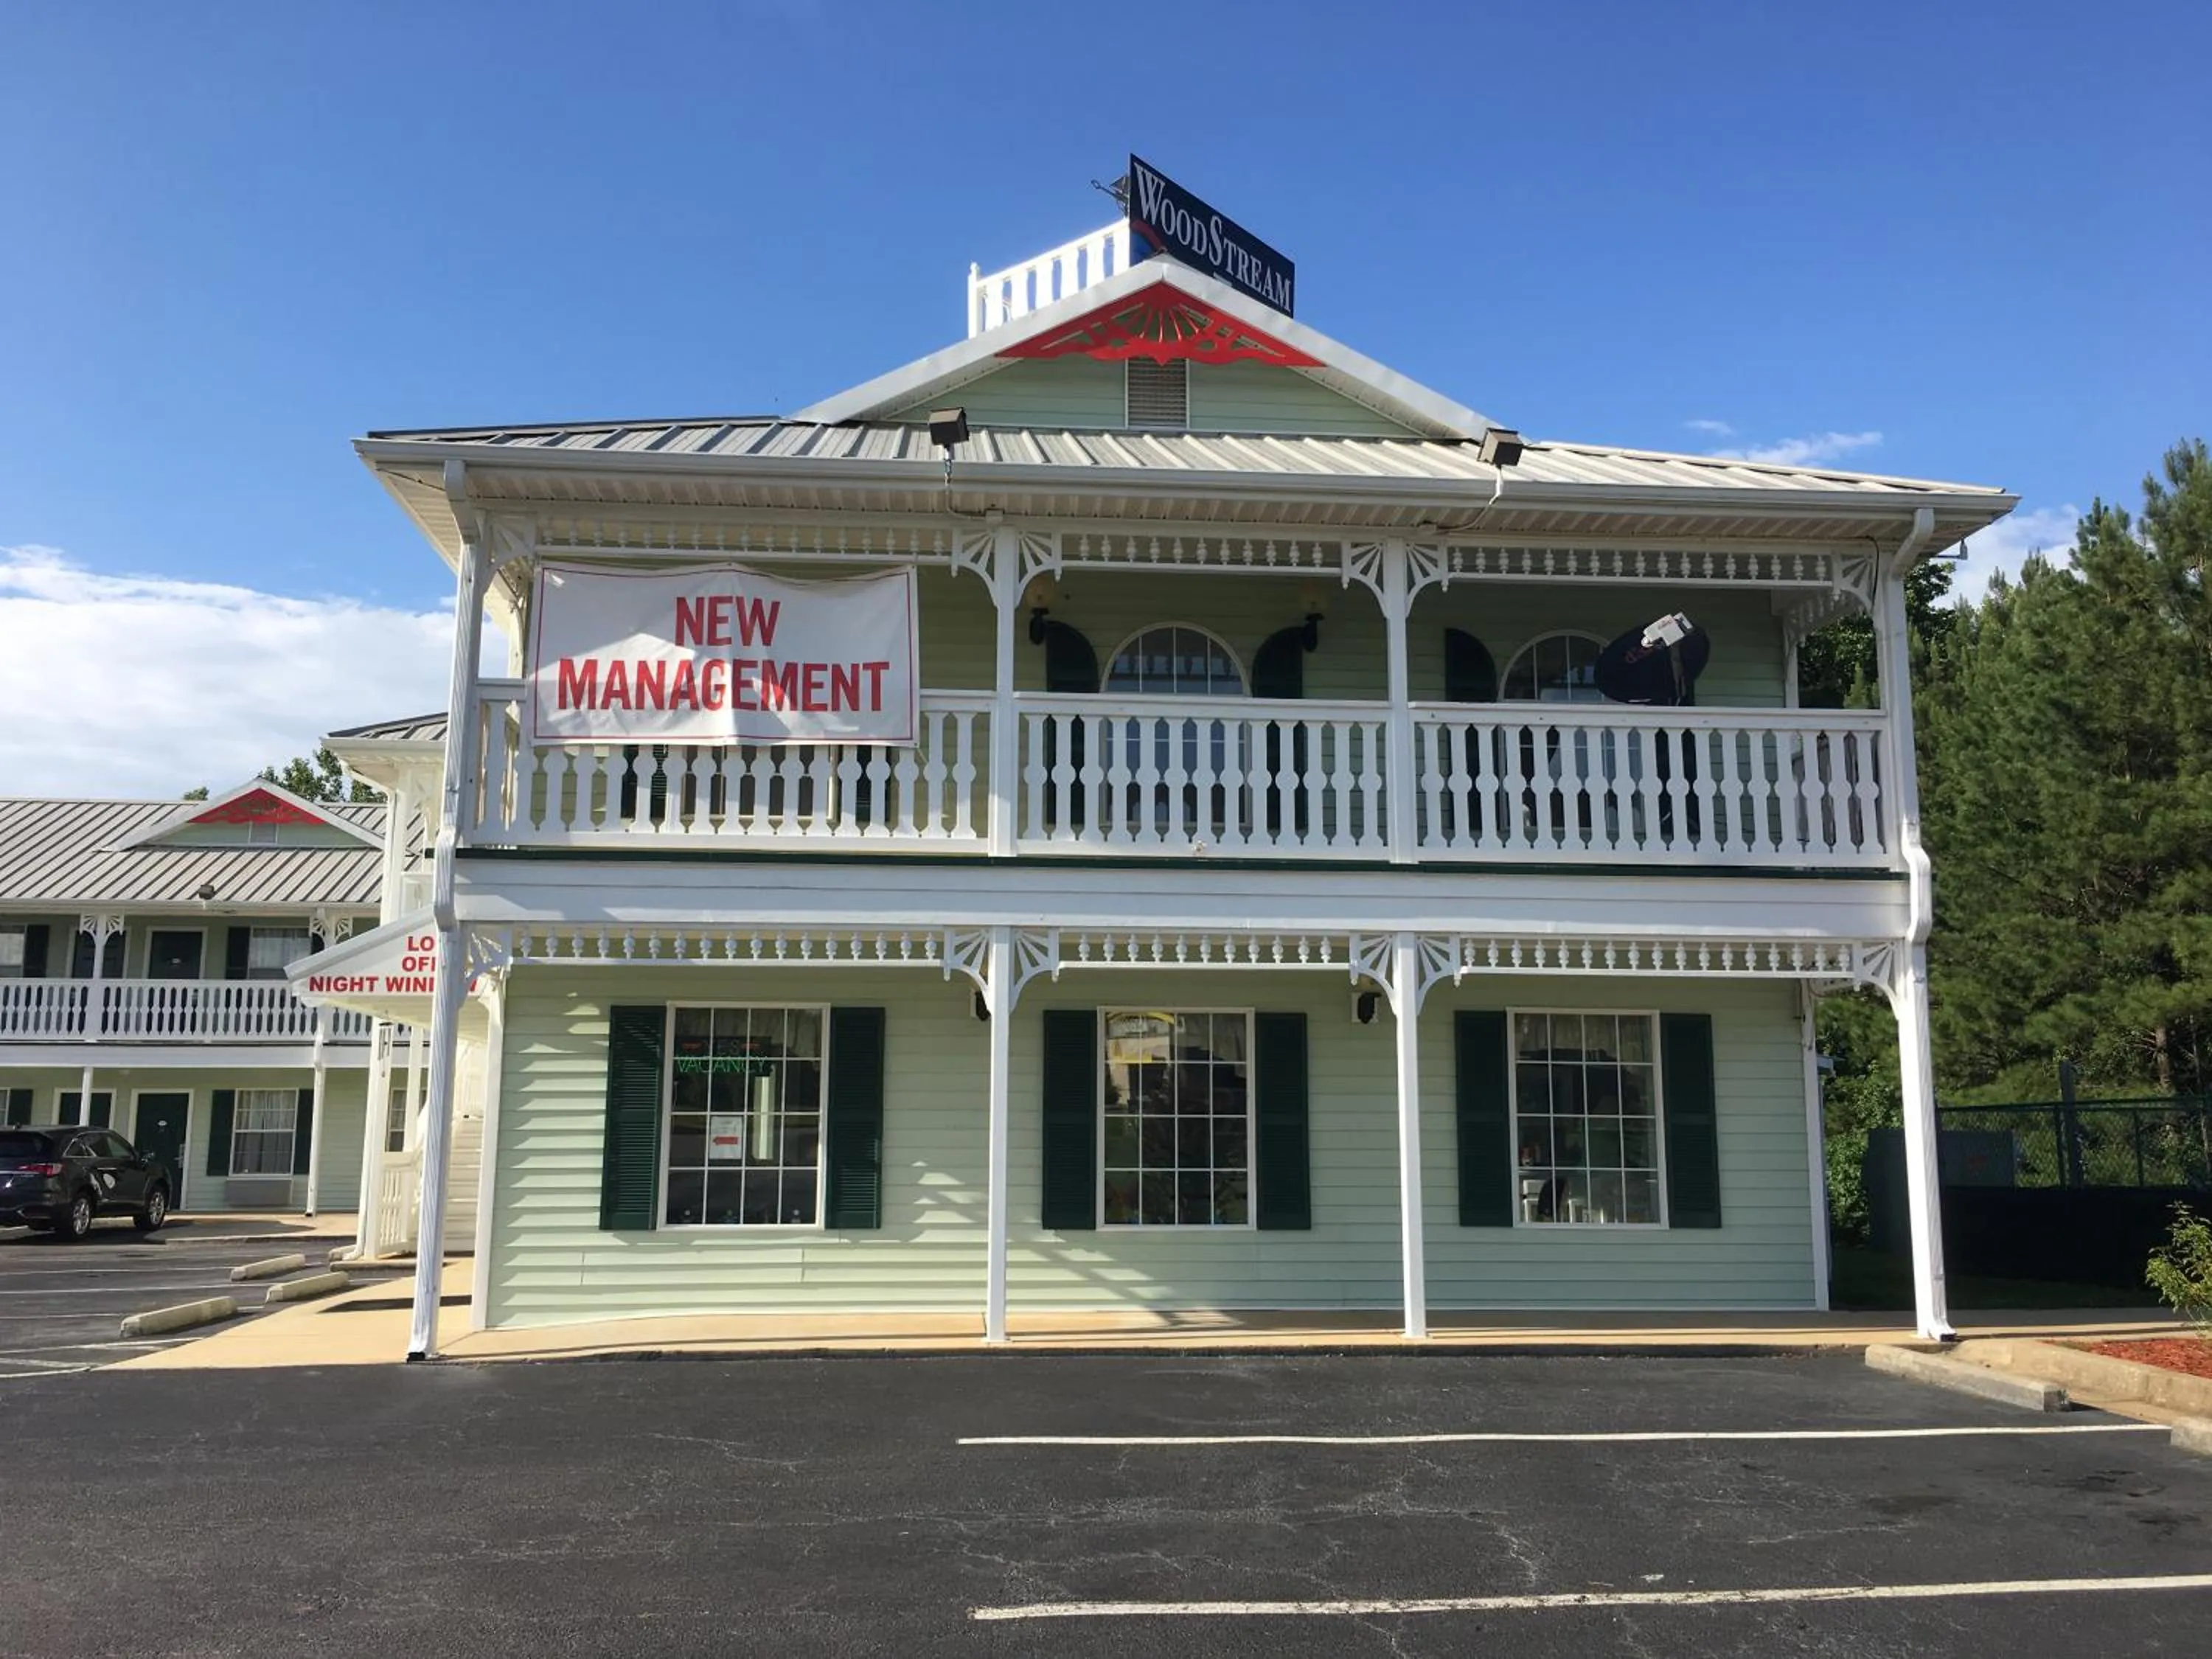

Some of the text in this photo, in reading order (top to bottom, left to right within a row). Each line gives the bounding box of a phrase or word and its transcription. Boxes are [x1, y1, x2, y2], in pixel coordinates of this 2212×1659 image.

[675, 595, 781, 647] NEW
[557, 658, 890, 712] MANAGEMENT
[408, 936, 434, 951] LO
[309, 975, 379, 992] NIGHT
[675, 1055, 768, 1074] VACANCY
